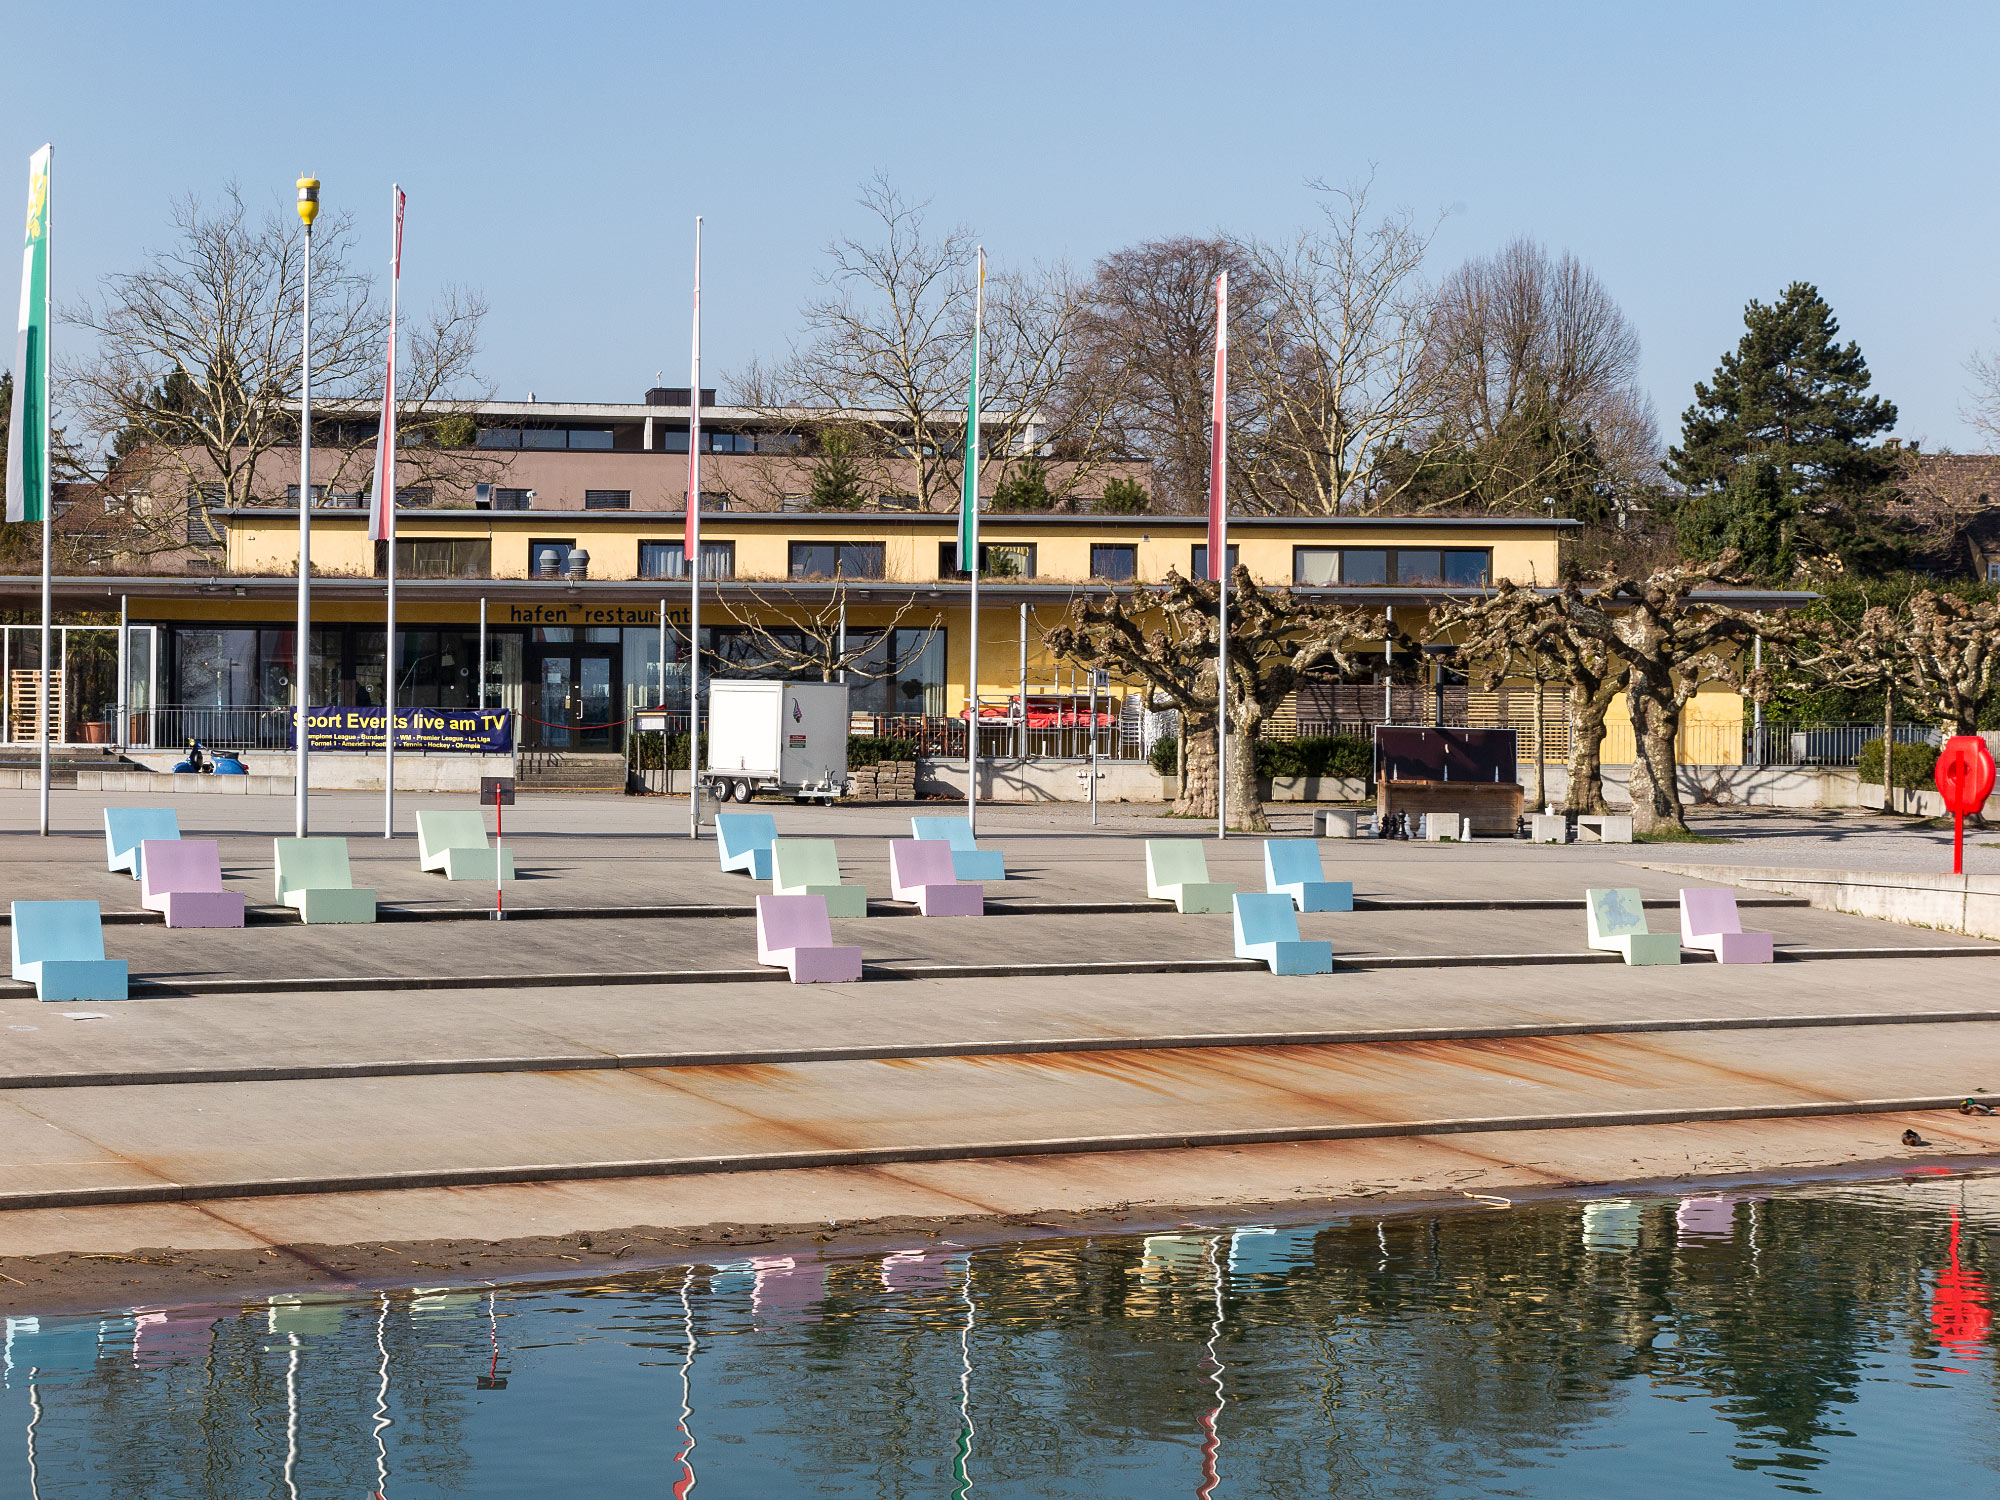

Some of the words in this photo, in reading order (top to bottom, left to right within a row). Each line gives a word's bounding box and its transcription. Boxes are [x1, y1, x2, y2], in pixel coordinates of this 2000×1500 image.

[511, 605, 567, 622] hafen
[413, 713, 445, 729] live
[449, 719, 476, 731] am
[481, 714, 505, 731] TV
[477, 736, 491, 744] Liga
